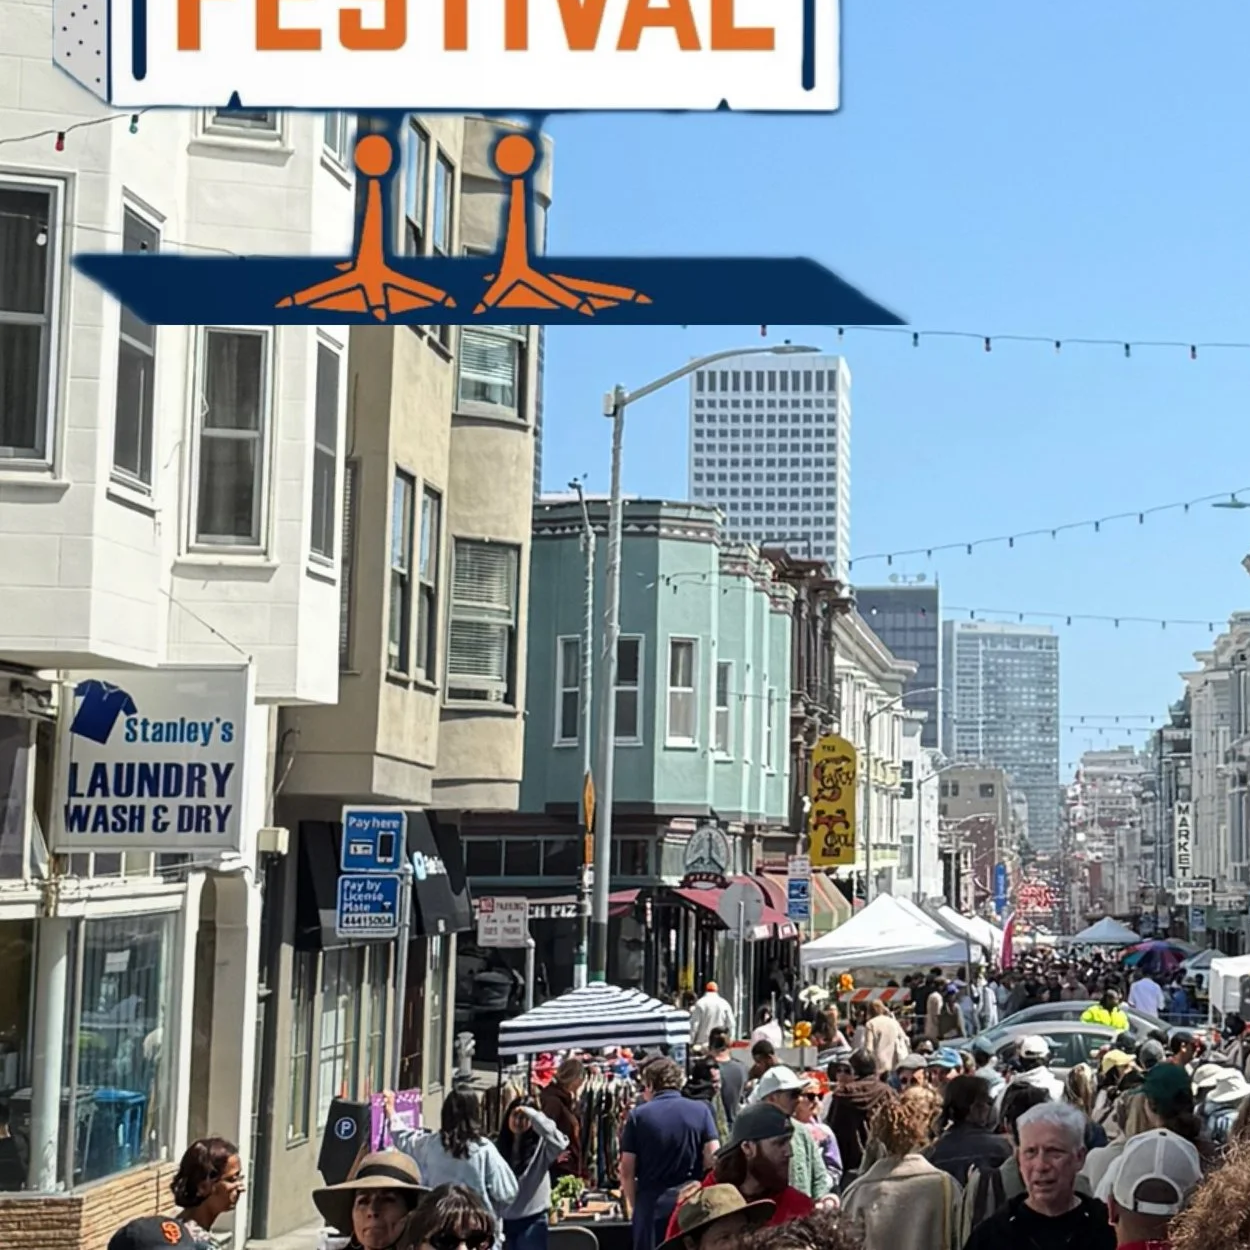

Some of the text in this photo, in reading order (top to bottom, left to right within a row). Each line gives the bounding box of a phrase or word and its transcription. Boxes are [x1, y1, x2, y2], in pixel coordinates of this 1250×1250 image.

[124, 717, 234, 747] Stanley's
[68, 762, 235, 798] LAUNDRY
[64, 804, 233, 834] WASH & DRY
[348, 816, 400, 830] Pay here
[1177, 804, 1190, 877] MARKET
[343, 880, 382, 892] Pay by
[343, 891, 384, 902] License
